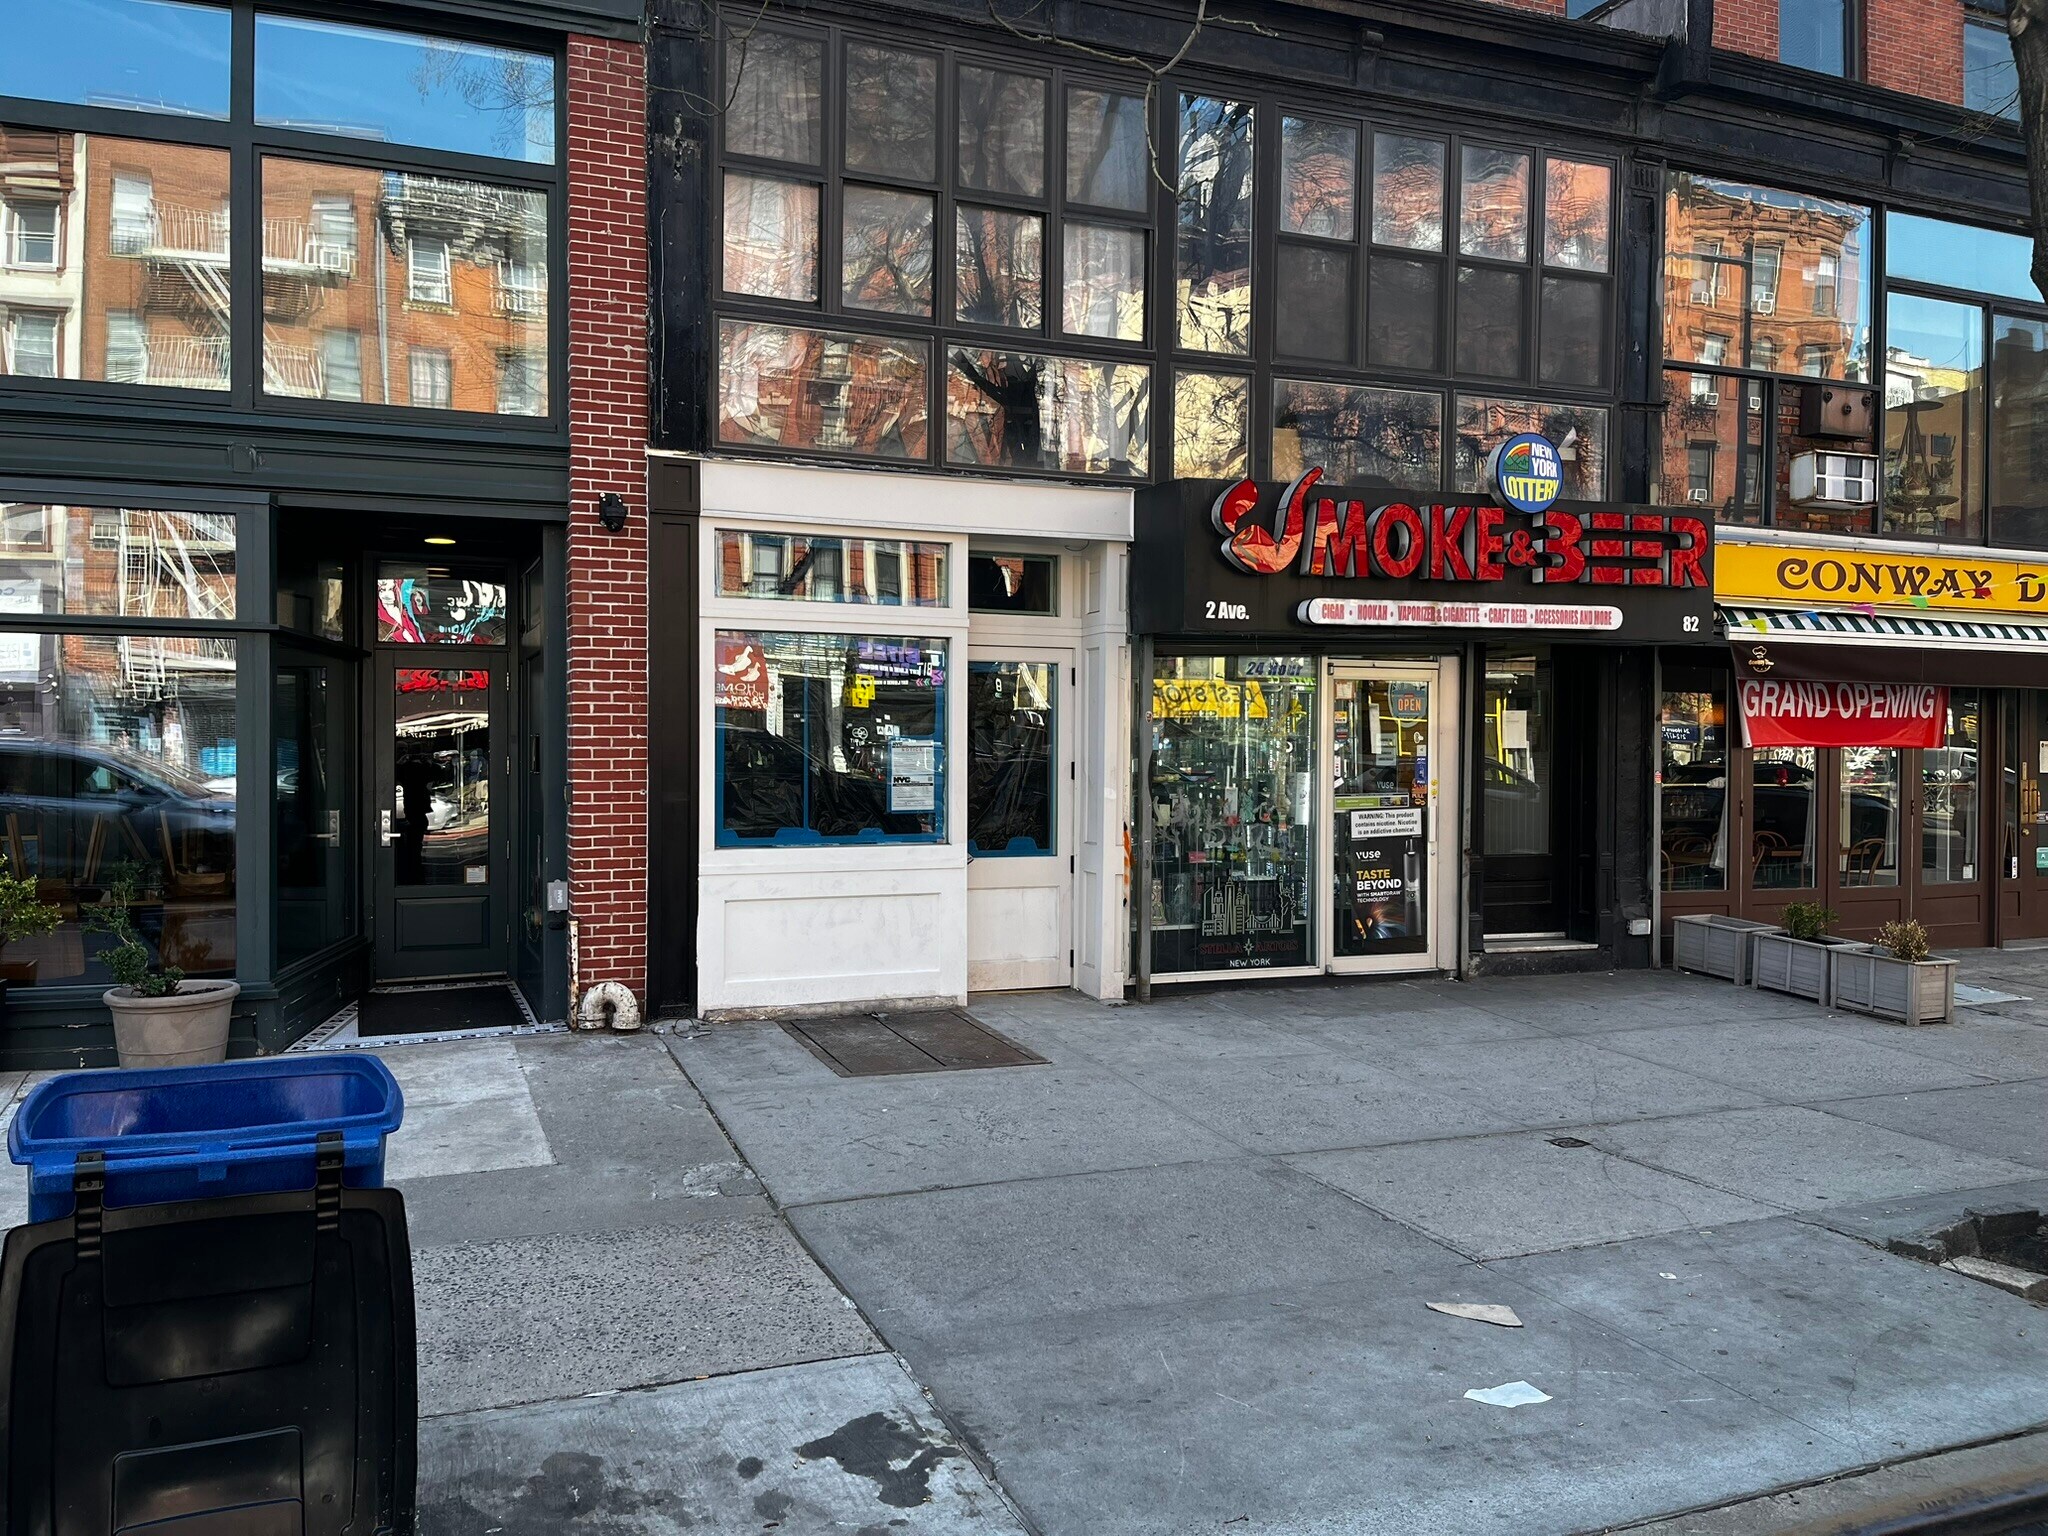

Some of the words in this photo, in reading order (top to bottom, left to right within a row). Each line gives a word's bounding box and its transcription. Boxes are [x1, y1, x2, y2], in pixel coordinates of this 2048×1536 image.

[1531, 442, 1553, 460] NEW
[1531, 457, 1558, 478] YORK
[1502, 475, 1559, 502] LOTTERY
[1505, 528, 1537, 568] &
[1533, 510, 1710, 587] BEER
[1776, 557, 1992, 600] CONWAY
[1205, 600, 1216, 619] 2
[1217, 601, 1250, 620] Ave.
[1321, 603, 1345, 620] CIGAR
[1357, 604, 1388, 621] HOOKAH
[1397, 605, 1436, 622] VAPORIZER
[1436, 608, 1442, 622] &
[1442, 606, 1480, 623] CIGARETTE
[1488, 607, 1509, 624] CRAFT
[1510, 608, 1527, 624] BEER
[1534, 608, 1578, 625] ACCESSORIES
[1579, 610, 1593, 625] AND
[1594, 610, 1612, 626] MORE
[1682, 615, 1700, 632] 82
[1246, 661, 1264, 676] 24
[1398, 698, 1421, 711] OPEN
[1742, 680, 1832, 719] GRAND
[1837, 682, 1936, 720] OPENING
[1396, 812, 1414, 820] product
[1370, 827, 1392, 835] addictive
[1356, 869, 1390, 880] TASTE
[1356, 879, 1402, 891] BEYOND
[1229, 959, 1248, 967] NEW
[1250, 958, 1271, 966] YORK
